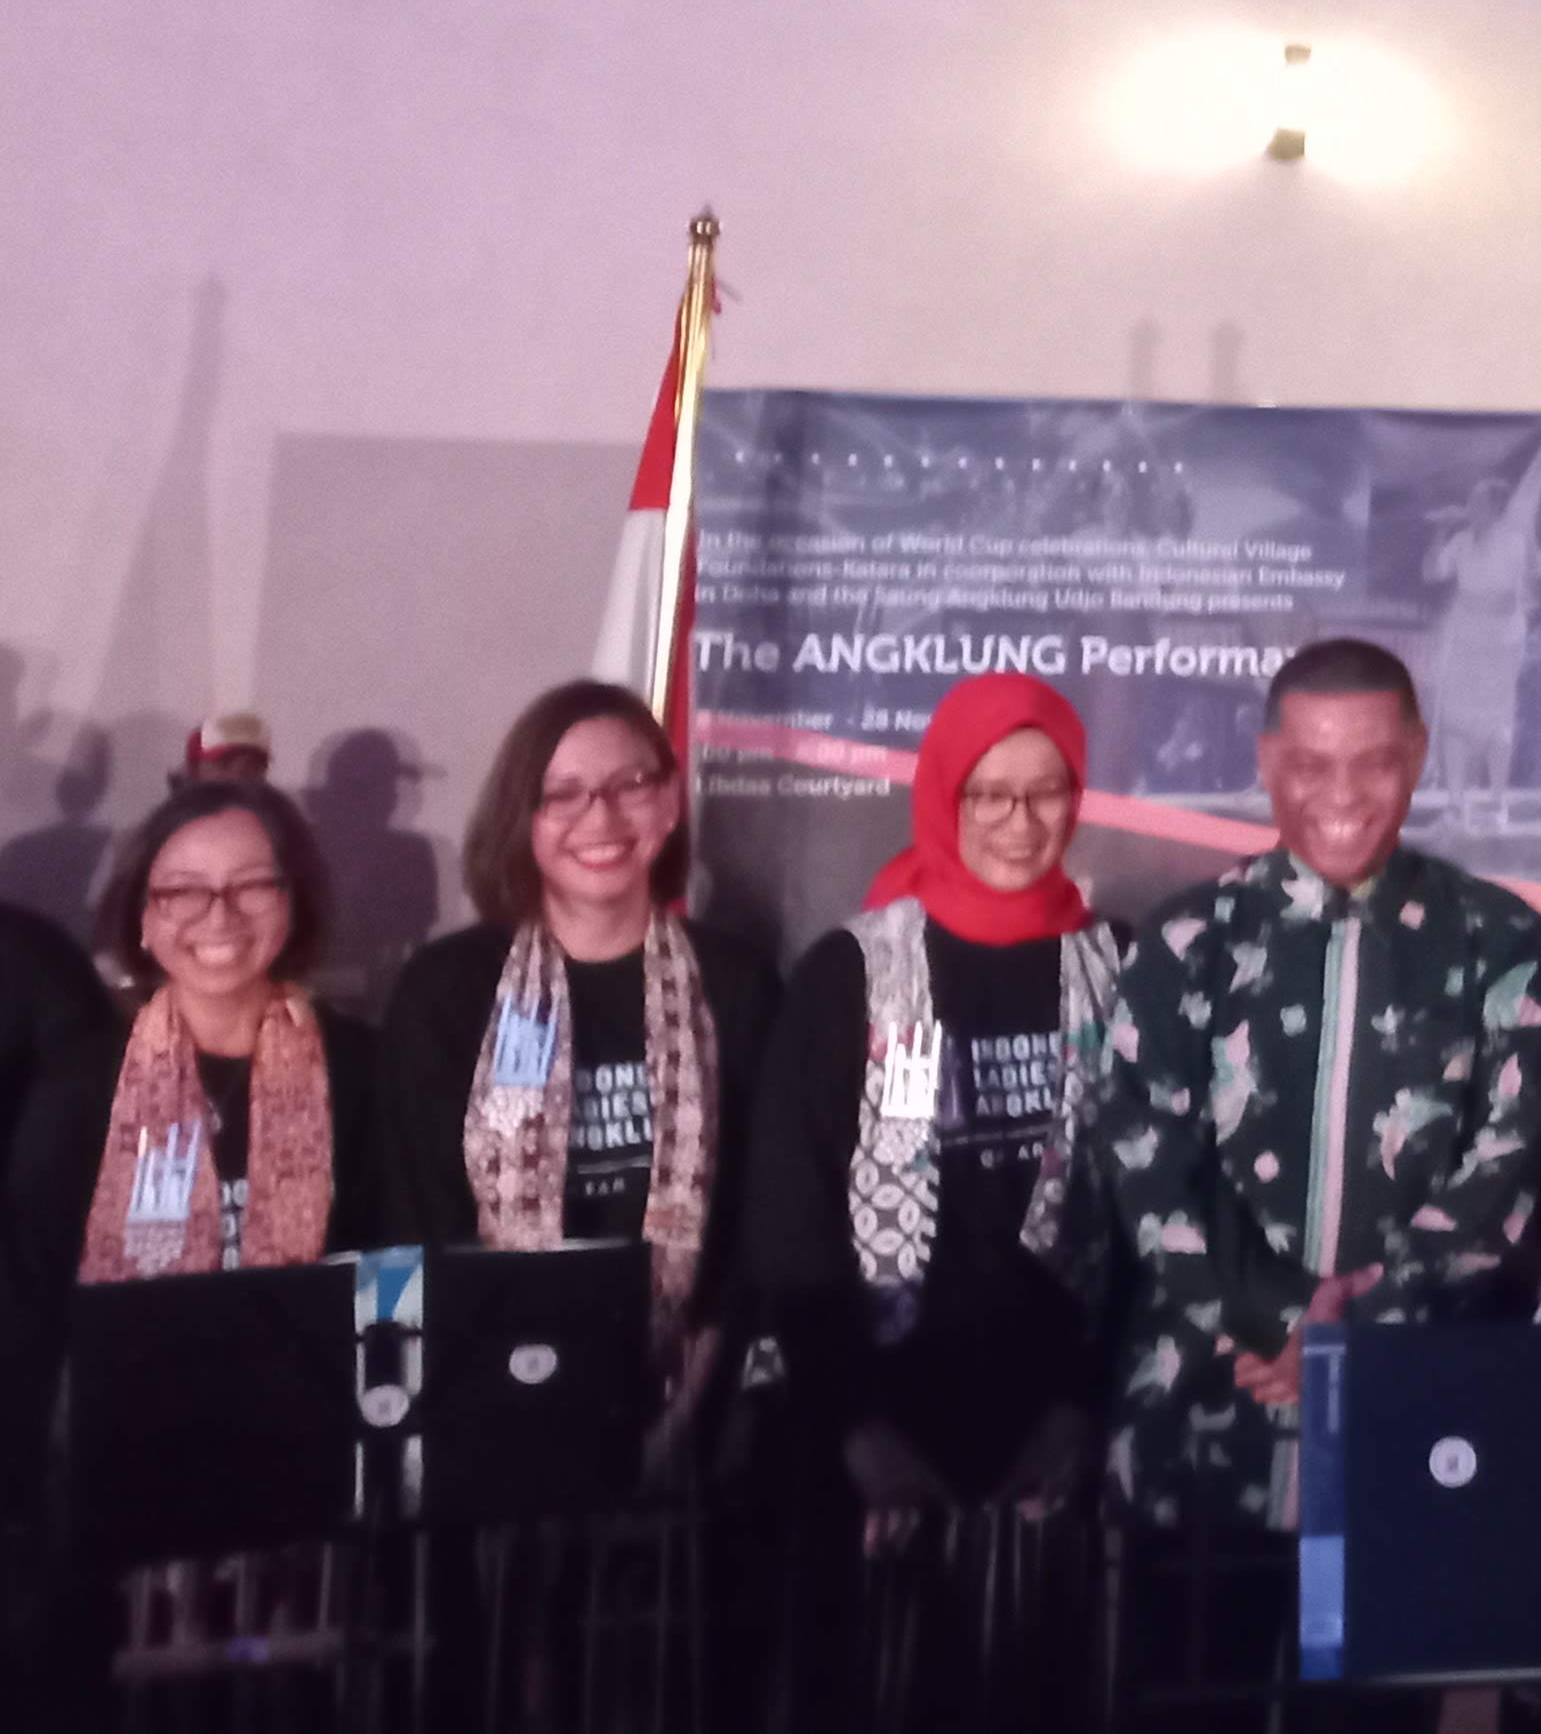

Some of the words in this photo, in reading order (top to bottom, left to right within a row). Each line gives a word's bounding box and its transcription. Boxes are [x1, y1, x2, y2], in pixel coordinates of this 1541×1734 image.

[872, 533, 893, 553] of
[900, 533, 963, 555] World
[970, 534, 1013, 558] Cup
[1245, 540, 1312, 565] Village
[1087, 565, 1133, 584] with
[1258, 568, 1346, 592] Embassy
[694, 632, 781, 673] The
[792, 632, 1068, 675] ANGKLUNG
[777, 773, 891, 801] Courtyard
